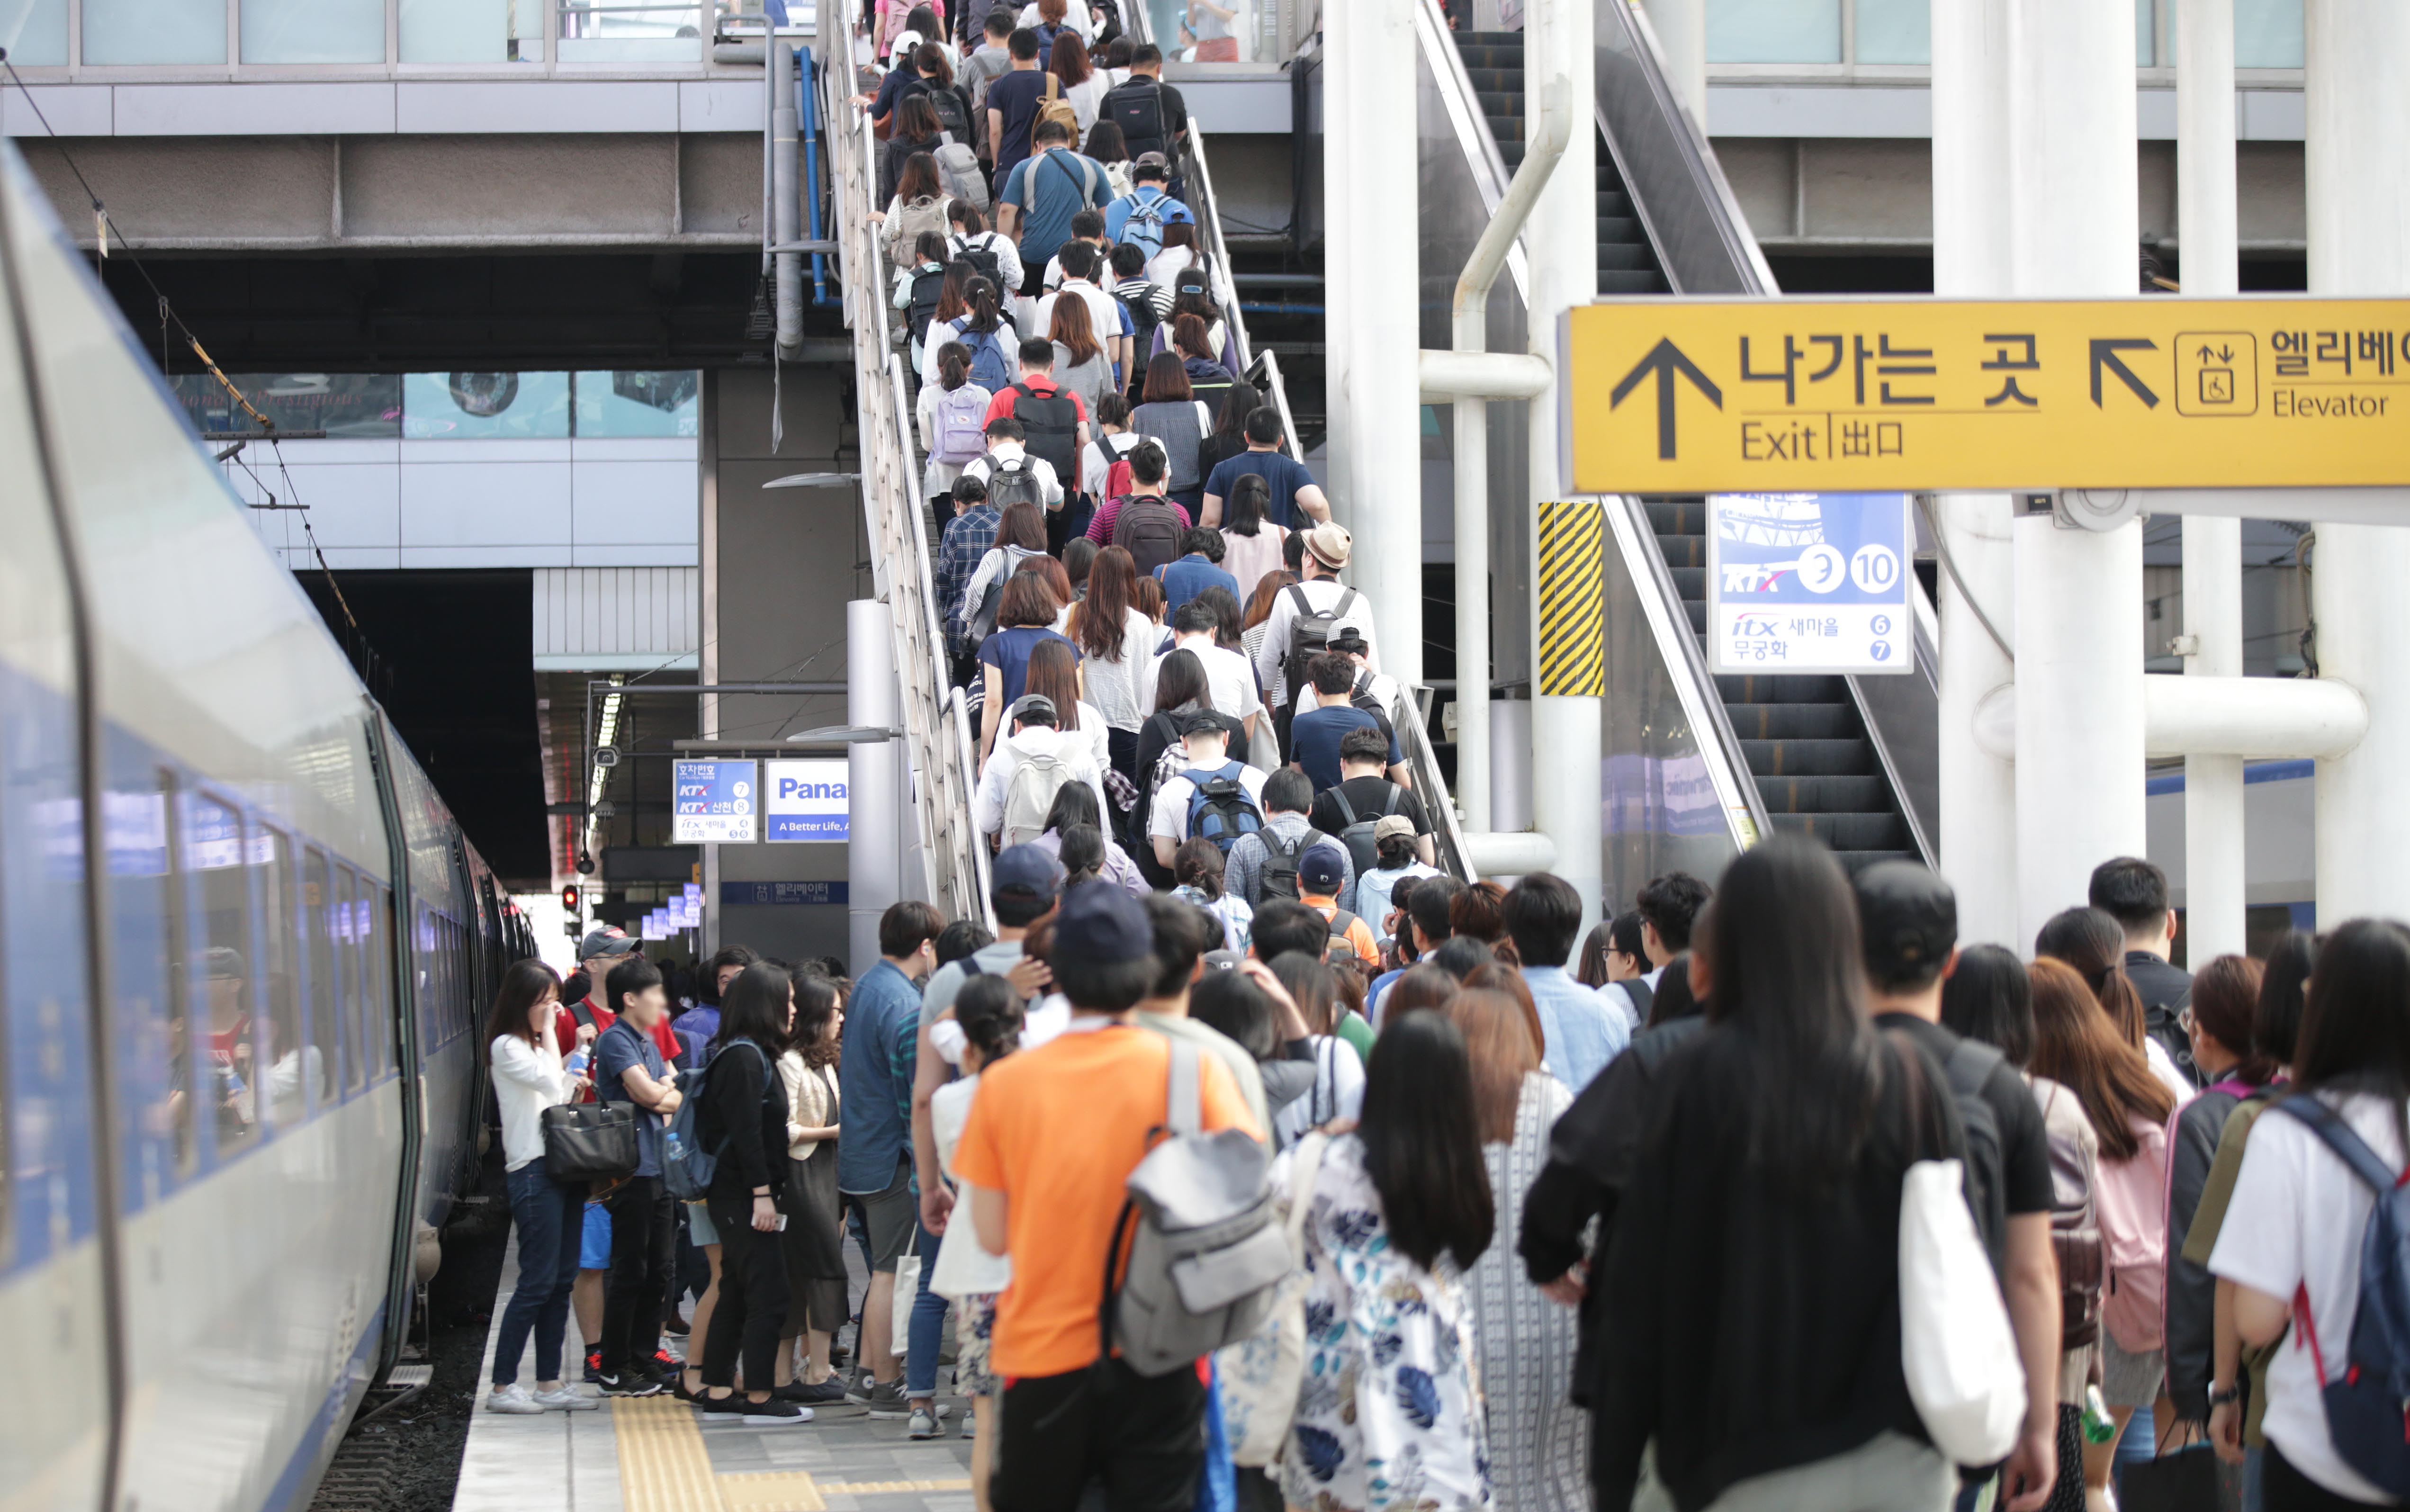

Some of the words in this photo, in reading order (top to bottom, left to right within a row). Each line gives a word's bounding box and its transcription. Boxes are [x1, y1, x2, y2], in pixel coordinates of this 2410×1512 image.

[2271, 330, 2410, 376] 엘리베
[1740, 333, 1937, 405] 나가는
[1980, 333, 2041, 406] 곳
[2273, 389, 2389, 417] Elevator
[1741, 421, 1817, 460] Exit
[1842, 420, 1904, 458] 出口
[1724, 570, 1788, 592] KTX
[1857, 553, 1893, 584] 10
[1732, 615, 1782, 636] itx
[1789, 617, 1839, 637] 새마을
[1873, 616, 1888, 635] 6
[1734, 640, 1789, 660] 무궁화
[1873, 641, 1888, 660] 7
[679, 764, 715, 775] 호차번호
[679, 784, 711, 796] KTX
[737, 784, 746, 795] 7
[780, 777, 849, 799] Pana
[679, 801, 711, 813] KTX
[712, 801, 731, 813] 산천
[737, 801, 746, 812] 8
[682, 819, 701, 828] itx
[705, 820, 726, 828] 새마을
[779, 822, 787, 831] A
[789, 822, 821, 831] Better
[823, 821, 843, 832] Life,
[683, 830, 705, 838] 무궁화
[775, 882, 828, 895] 엘리베이터
